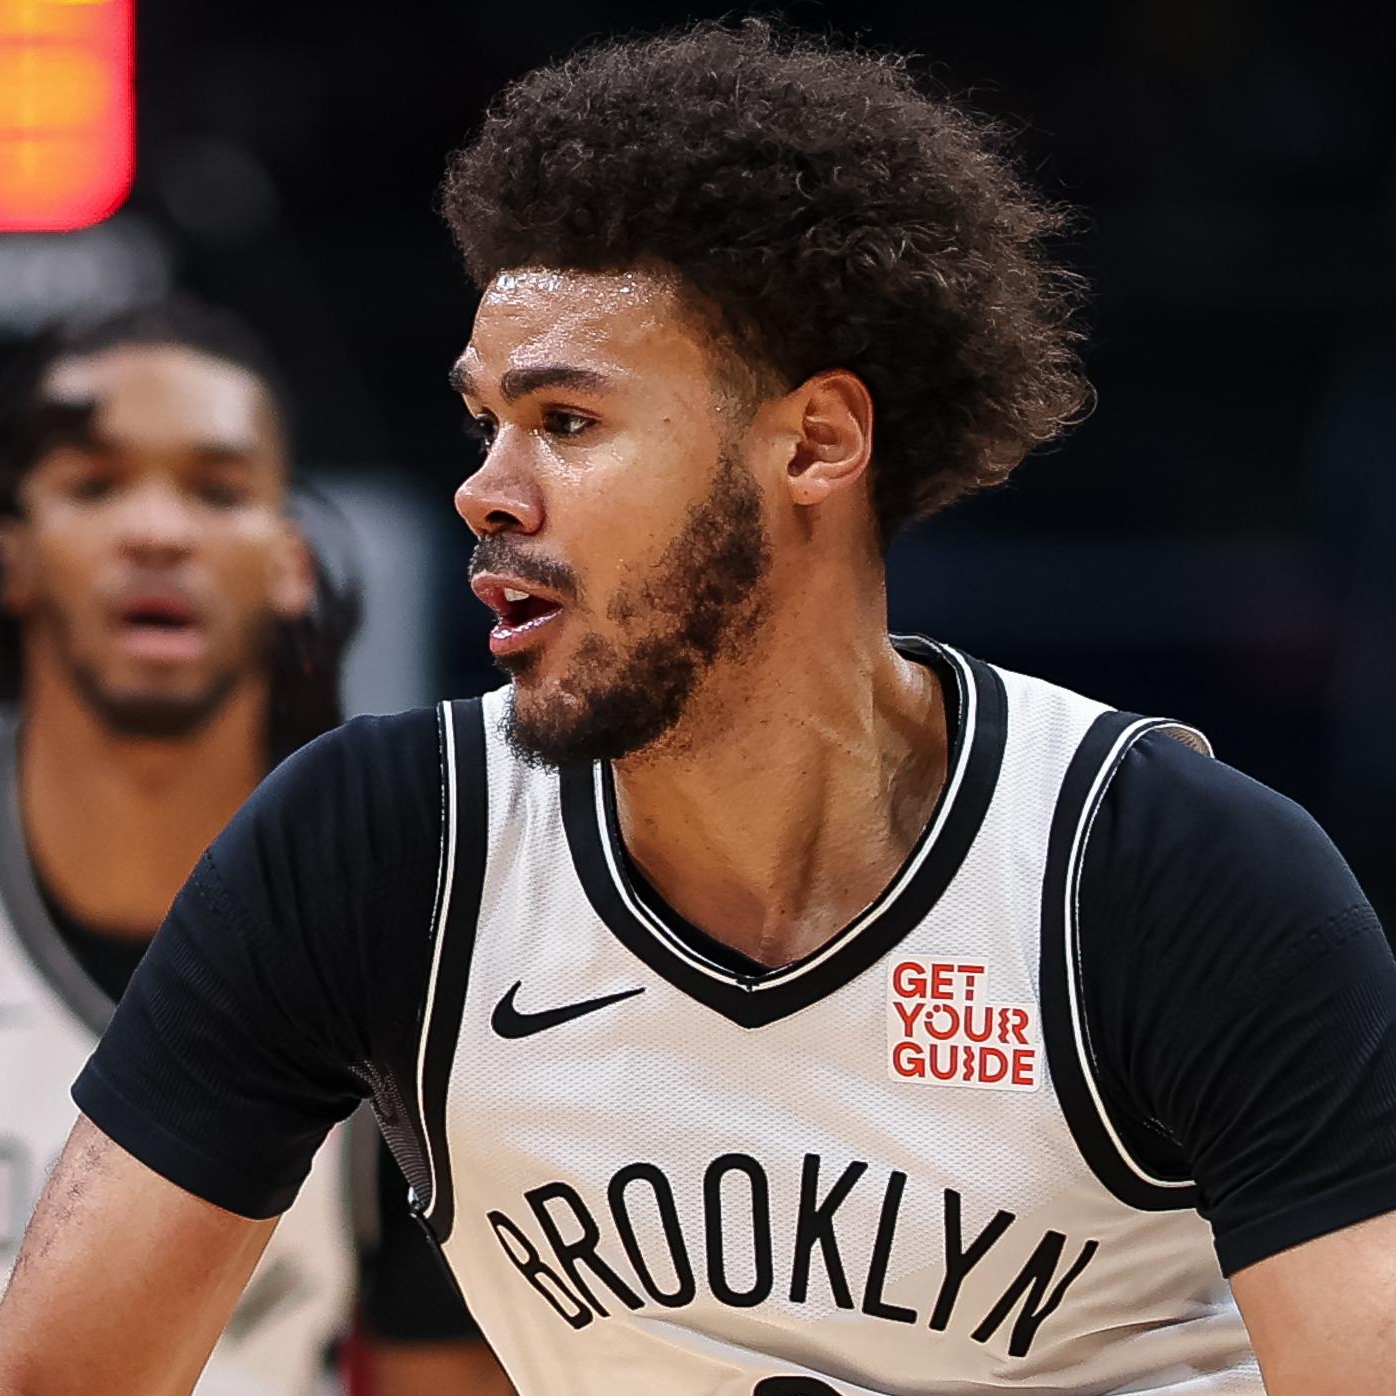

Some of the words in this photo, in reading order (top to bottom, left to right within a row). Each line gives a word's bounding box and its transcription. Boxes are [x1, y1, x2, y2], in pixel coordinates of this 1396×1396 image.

[892, 961, 985, 1001] GET
[892, 1001, 1030, 1045] YOUR
[892, 1041, 1036, 1086] GUIDE
[487, 1152, 1099, 1358] BROOKLYN
